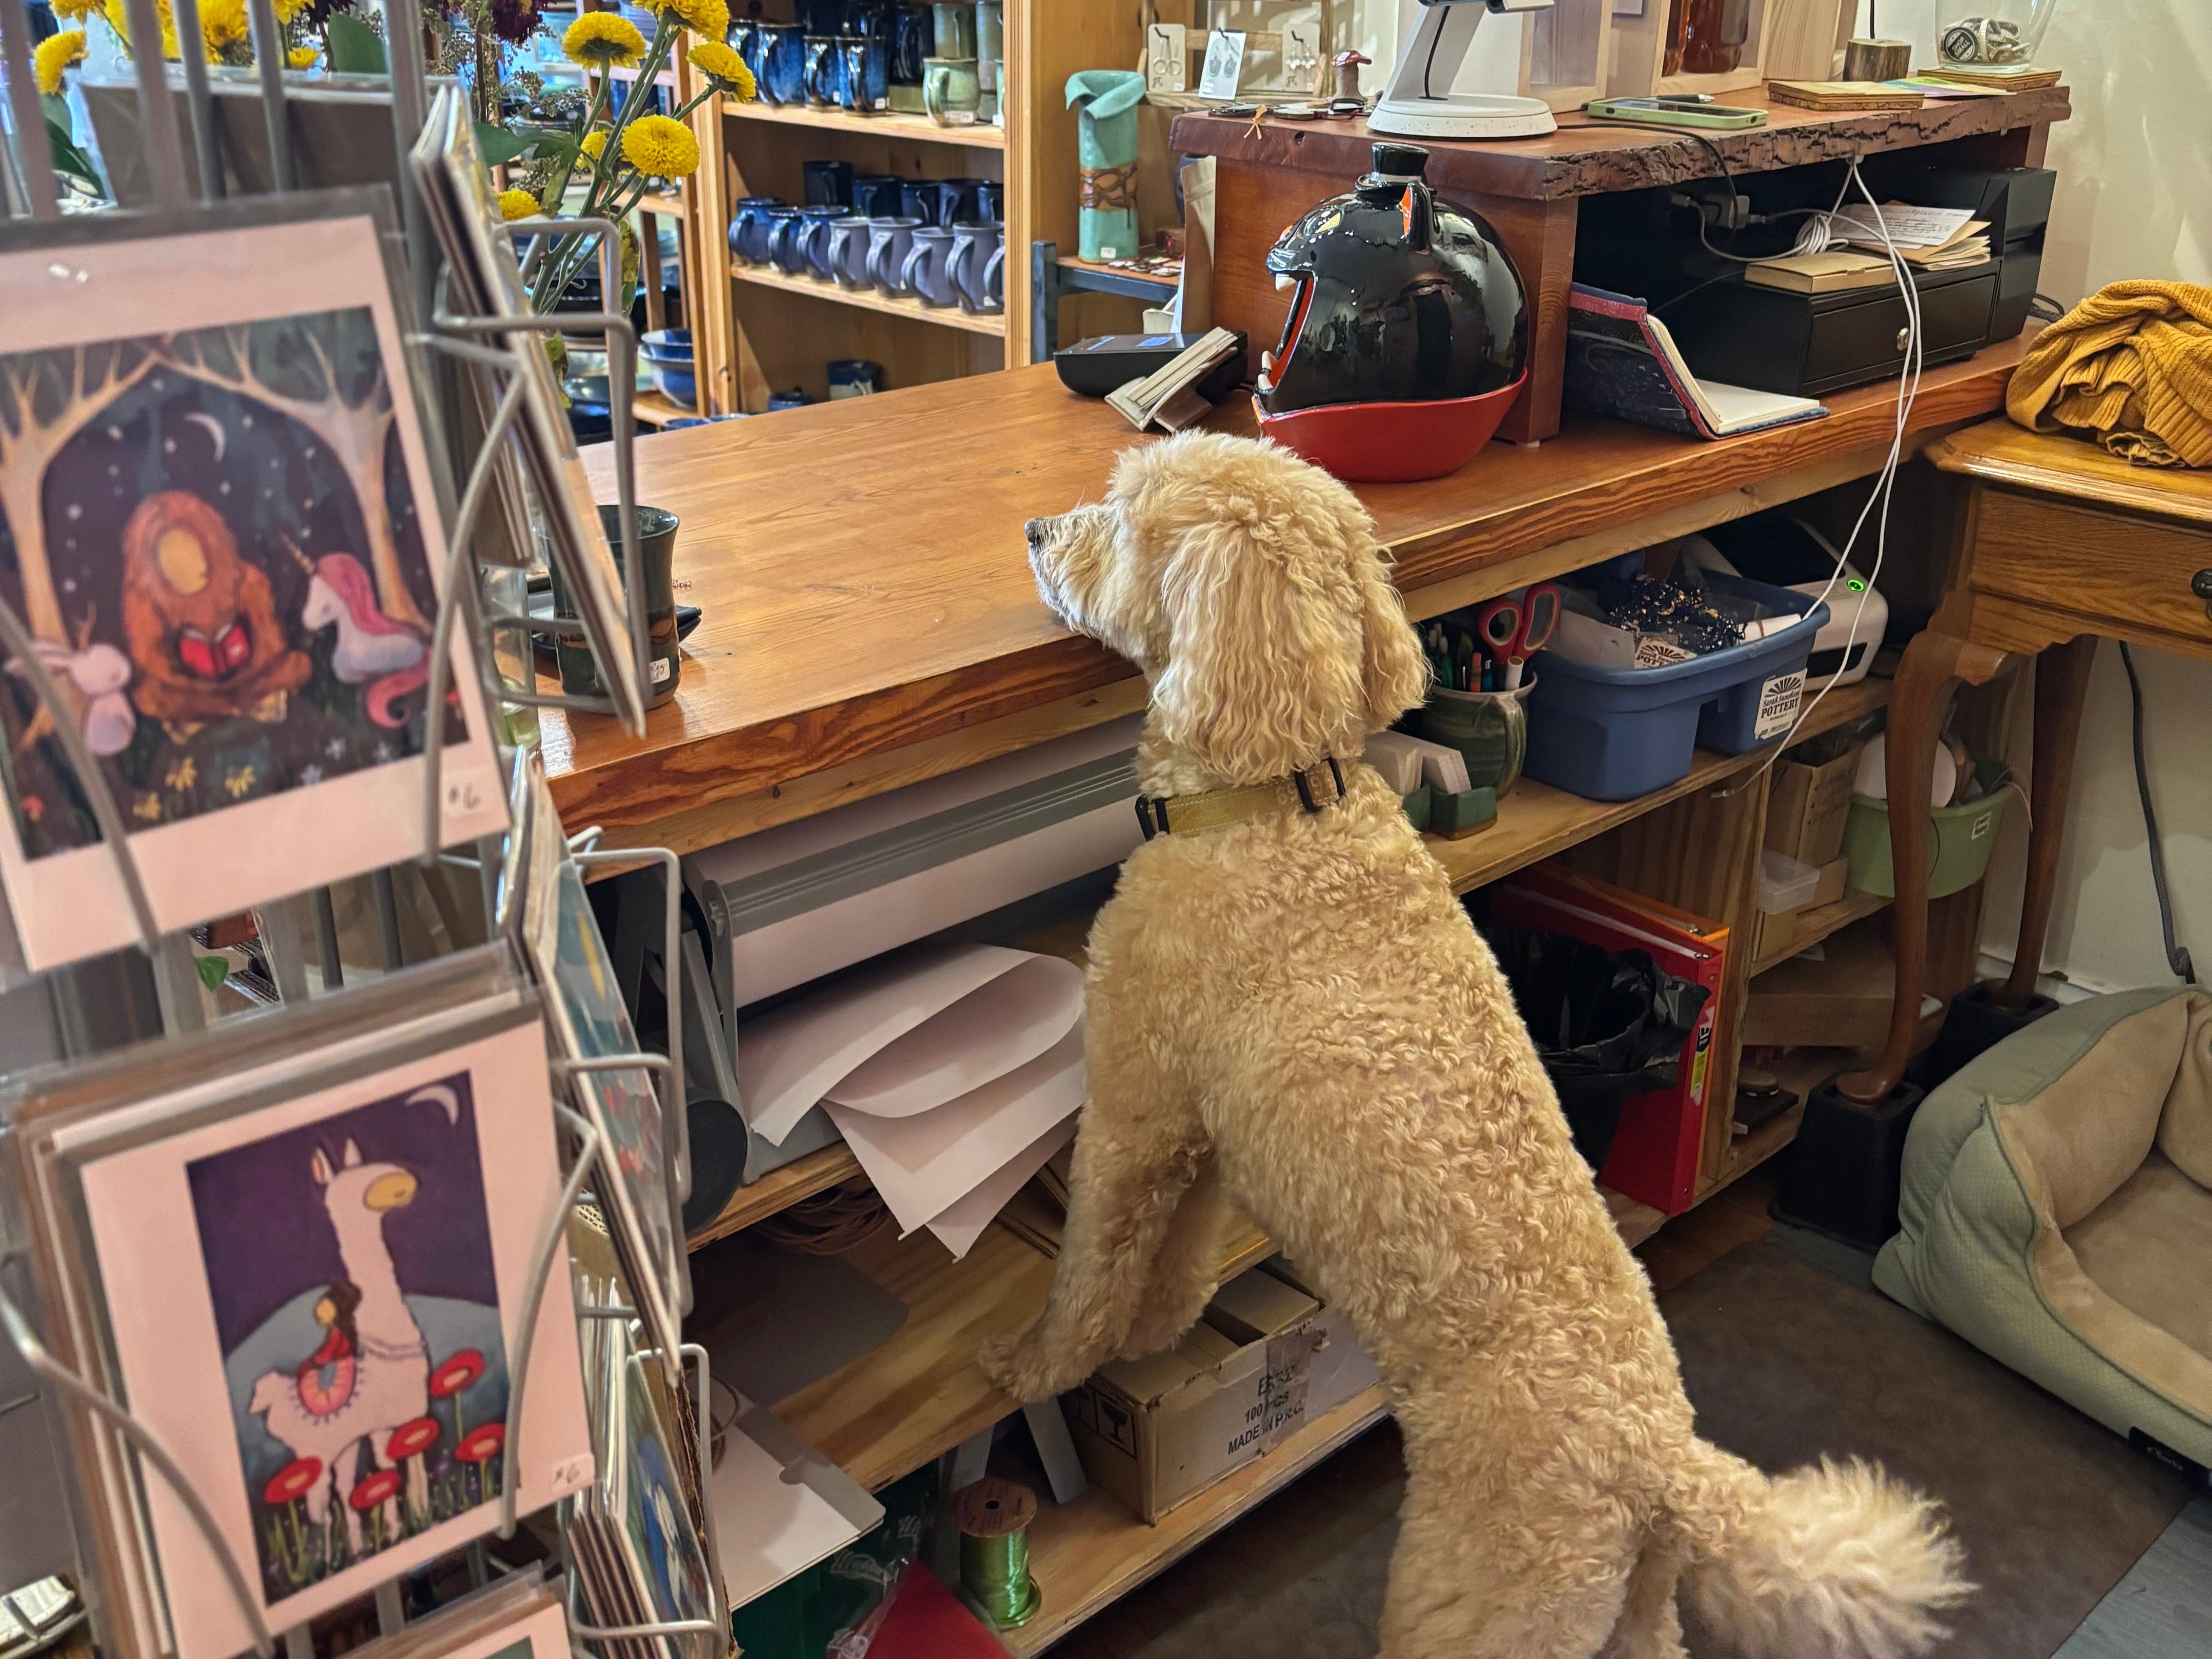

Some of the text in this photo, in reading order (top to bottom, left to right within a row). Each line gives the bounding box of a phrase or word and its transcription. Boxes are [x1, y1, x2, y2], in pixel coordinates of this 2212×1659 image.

[1951, 36, 1965, 50] SHOP
[1954, 40, 1970, 57] SMALL
[1228, 1424, 1260, 1455] MADE
